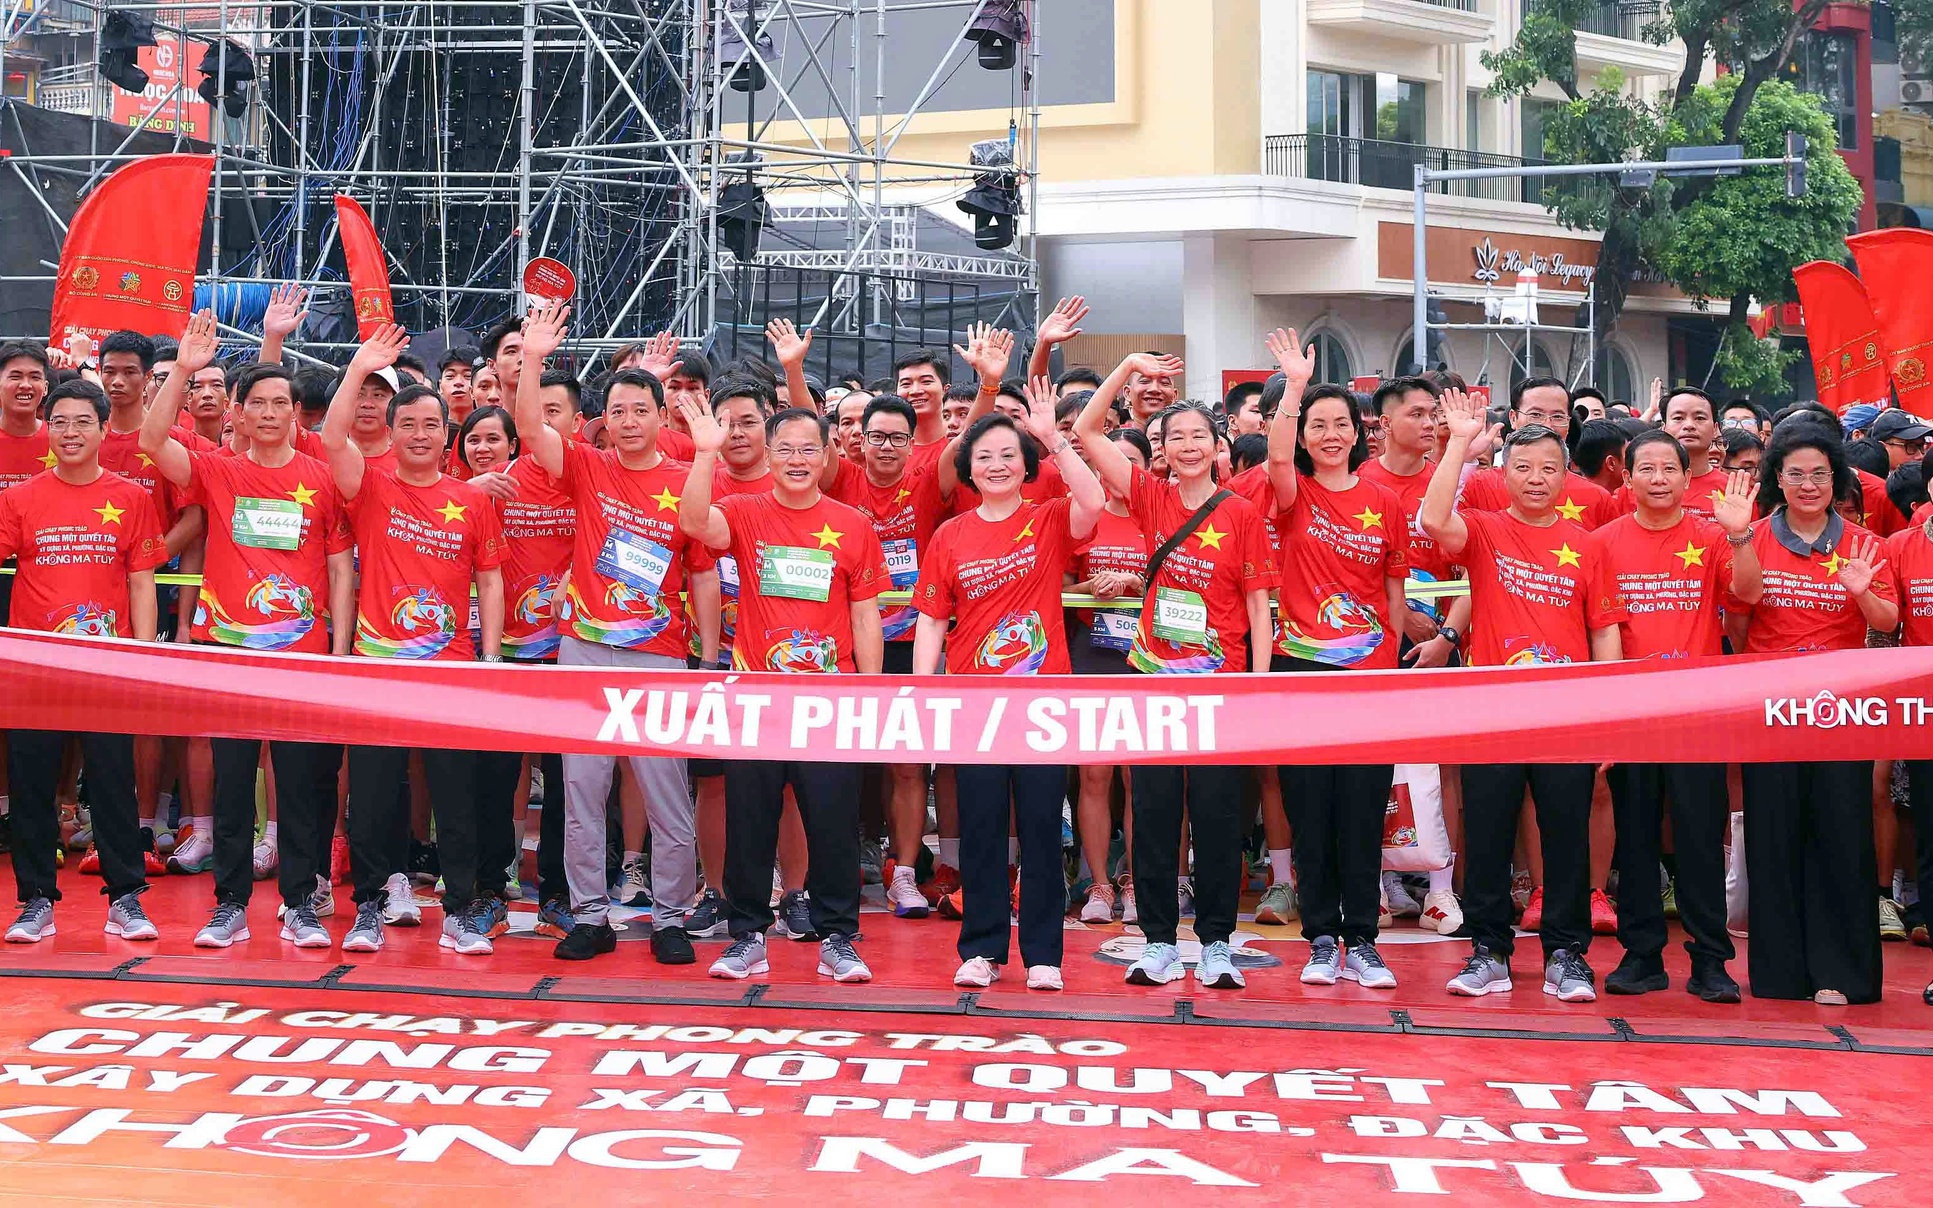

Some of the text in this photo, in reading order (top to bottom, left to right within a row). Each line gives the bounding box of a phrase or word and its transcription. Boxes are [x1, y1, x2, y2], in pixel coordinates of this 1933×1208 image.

[165, 119, 195, 133] DNH
[1501, 250, 1524, 273] Hà
[1550, 253, 1595, 287] Legacy
[257, 516, 299, 529] 44444
[618, 509, 674, 532] MỘT QUYẾT TÂM
[36, 534, 61, 545] CHUNG
[62, 533, 77, 543] MỘT
[79, 531, 102, 543] QUYẾT
[424, 528, 446, 539] QUYẾT
[448, 532, 462, 541] TÂM
[73, 554, 92, 563] MA
[94, 554, 115, 565] TÚY
[416, 544, 458, 561] MA TÚY
[1336, 545, 1379, 565] MA TÚY
[626, 551, 663, 575] 99999
[1199, 559, 1214, 570] TÂM
[786, 565, 828, 579] 00002
[999, 573, 1016, 585] MA
[1516, 568, 1575, 588] MỘT QUYẾT TÂM
[1645, 582, 1661, 592] MỘT
[1662, 579, 1684, 589] QUYẾT
[1686, 579, 1701, 589] TÂM
[1783, 579, 1801, 588] MỘT
[1802, 581, 1828, 590] QUYẾT
[1526, 592, 1570, 608] MA TÚY
[1626, 600, 1701, 613] HÔNG MA TÚY
[1795, 599, 1815, 609] MA
[1818, 602, 1844, 612] TÚY
[1165, 607, 1202, 621] 39222
[1913, 604, 1933, 616] KHÔ
[1116, 620, 1137, 631] 506
[596, 675, 1225, 753] XUẤT PHÁT / START
[1764, 689, 1888, 729] KHÔNG
[74, 1000, 1128, 1057] GIẢI CHẠY PHONG TRÀO
[27, 1028, 1843, 1118] CHUNG MỘT QUYẾT TÂM
[0, 1063, 1869, 1153] XÂY DỰNG XÃ, PHƯỜNG, ĐẶC KHU
[0, 1106, 1900, 1208] KHÔNG MA TÚY
